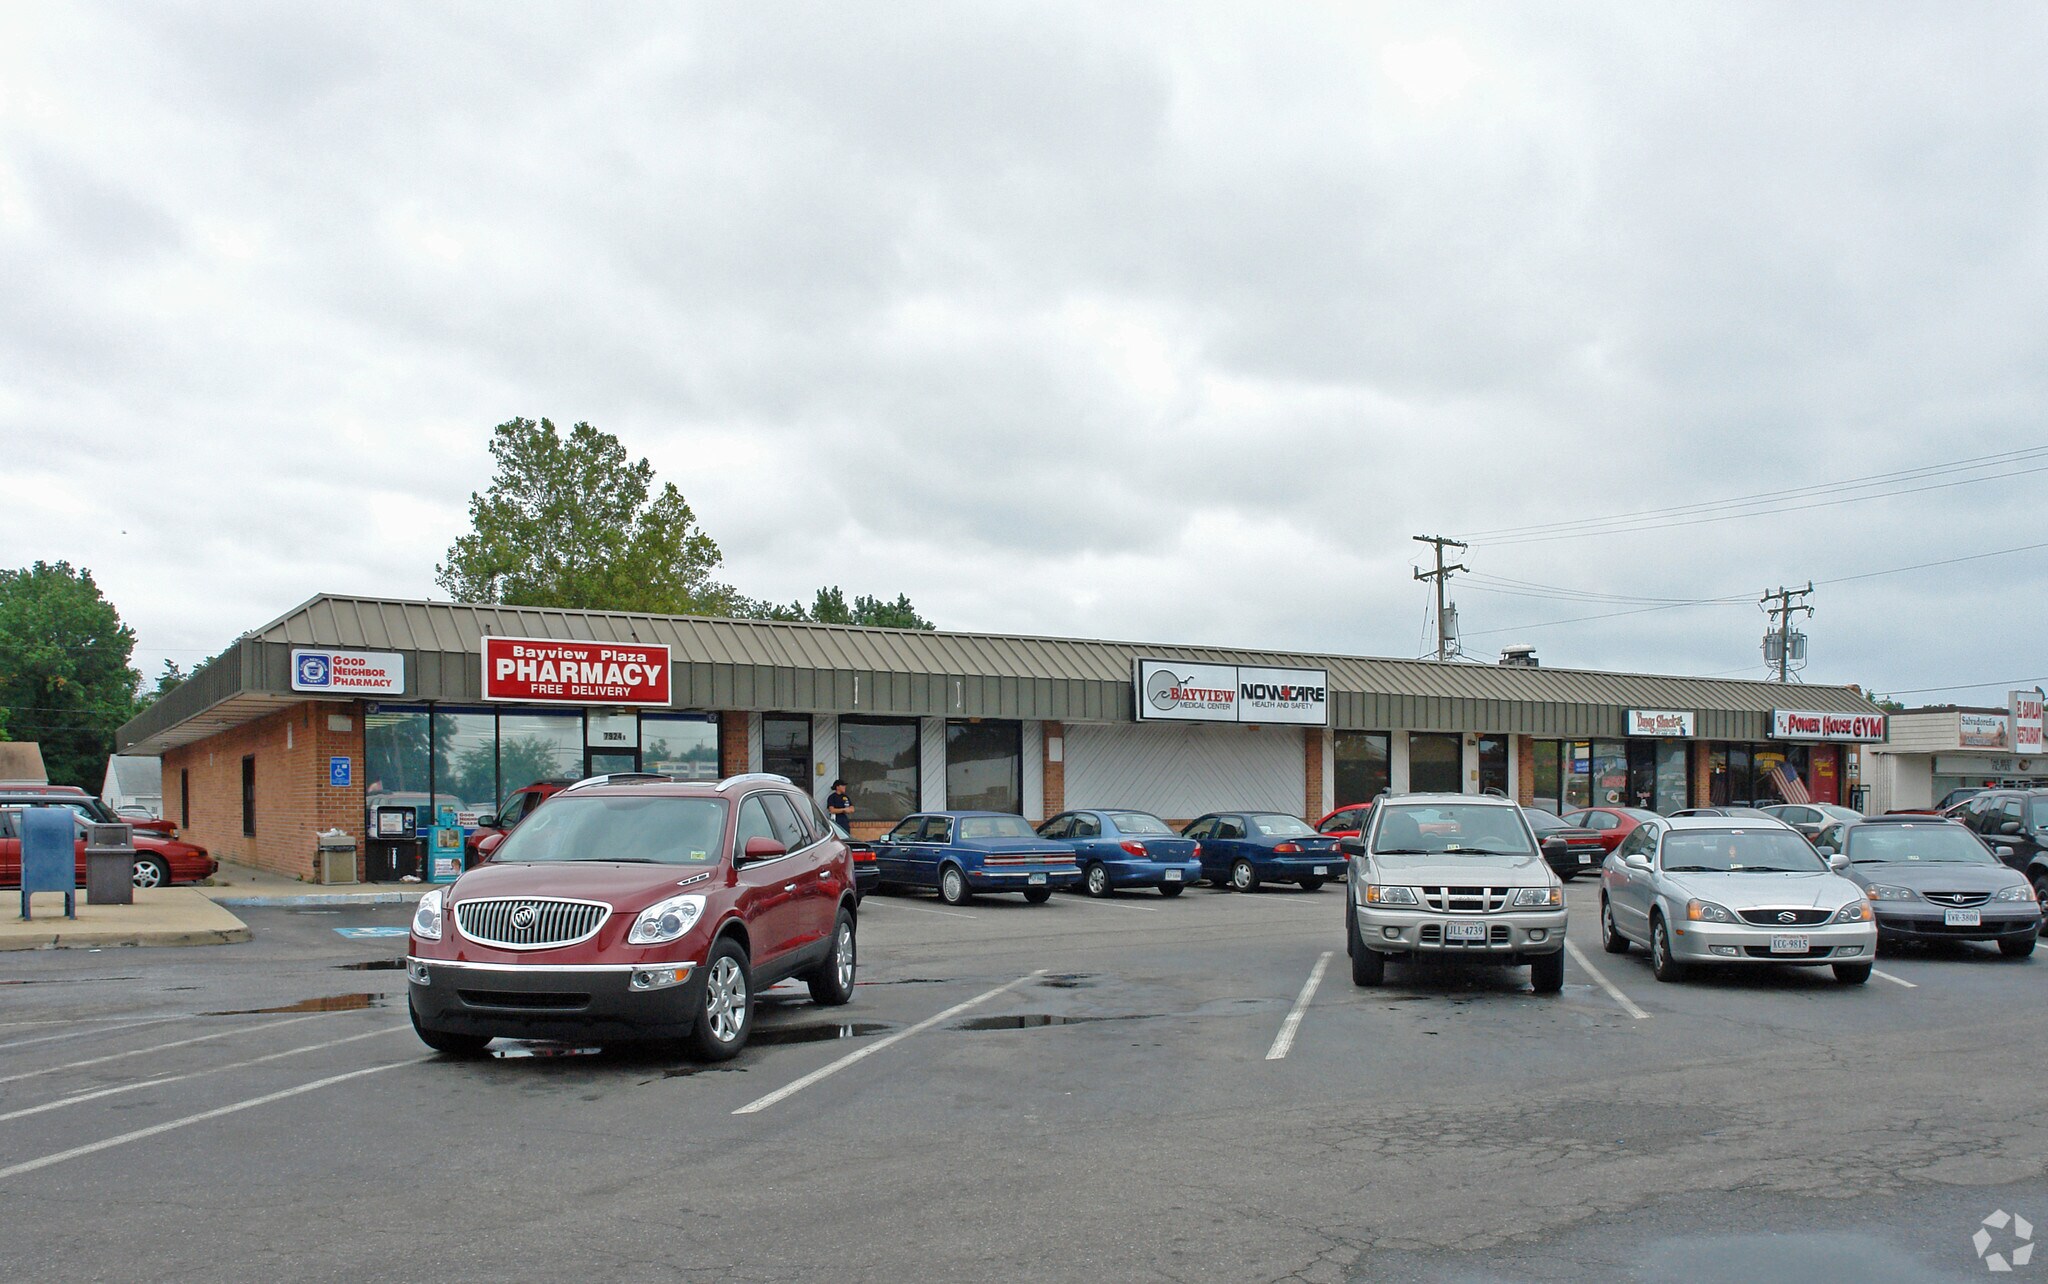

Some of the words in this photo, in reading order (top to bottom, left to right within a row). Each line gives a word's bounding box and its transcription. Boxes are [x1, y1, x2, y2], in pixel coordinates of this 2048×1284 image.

[513, 646, 588, 661] Bayview
[601, 650, 647, 662] Plaza
[333, 656, 366, 666] GOOD
[333, 666, 385, 677] NEIGHBOR
[496, 658, 662, 686] PHARMACY
[333, 676, 392, 687] PHARMACY
[531, 684, 563, 694] FREE
[571, 686, 631, 696] DELIVERY
[1169, 687, 1235, 703] BAYVIEW
[1180, 701, 1206, 709] MEDICAL
[1291, 702, 1313, 710] SAFETY
[2017, 701, 2023, 718] EL
[1788, 714, 1820, 735] POWER
[1822, 716, 1852, 736] HOUSE
[1853, 717, 1882, 738] GYM
[603, 732, 622, 740] 7924
[1449, 926, 1483, 935] JLL-4739
